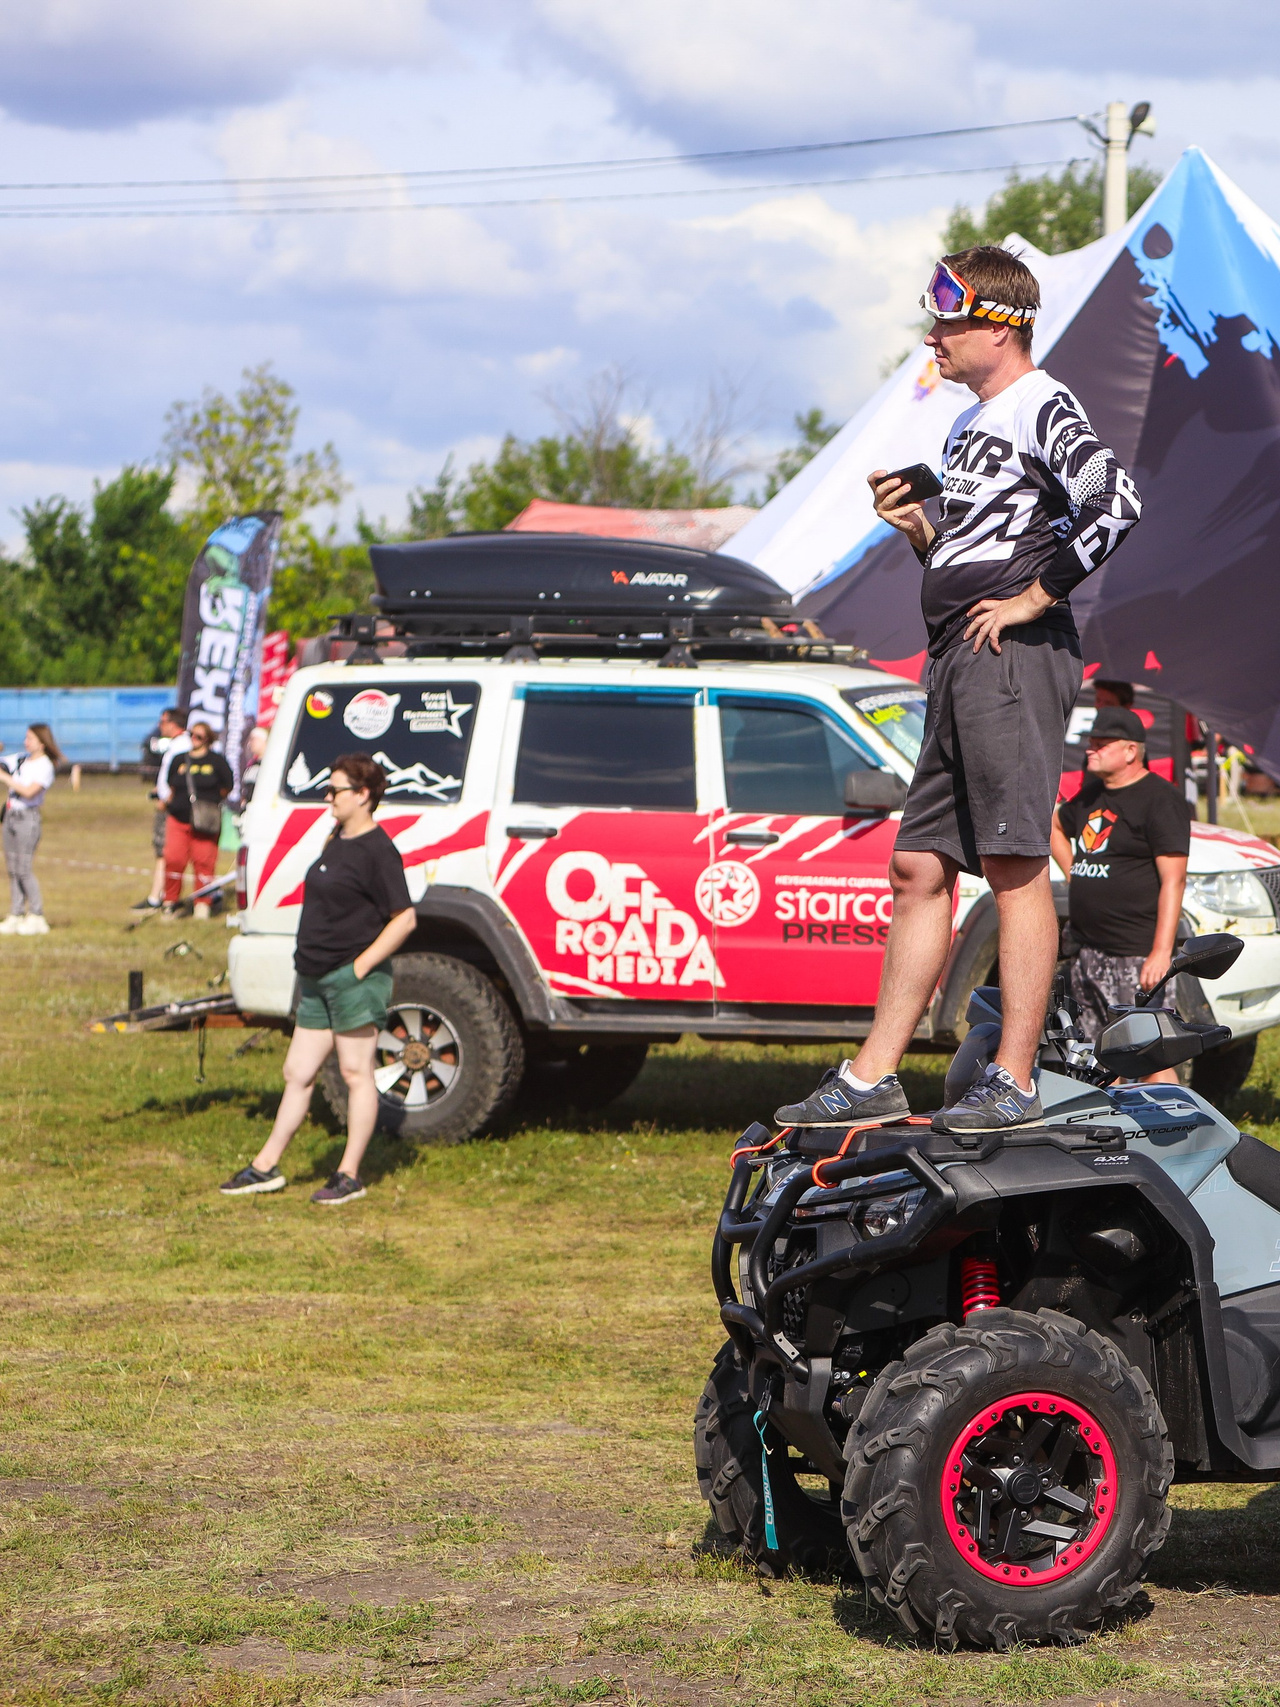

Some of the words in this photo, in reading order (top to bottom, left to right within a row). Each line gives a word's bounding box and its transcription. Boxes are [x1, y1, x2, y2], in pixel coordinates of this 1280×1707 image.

[630, 571, 688, 587] AVATAR
[545, 850, 676, 923] OFF
[555, 909, 699, 959] ROAD
[587, 934, 727, 988] MEDIA
[1151, 1124, 1198, 1135] TOURING
